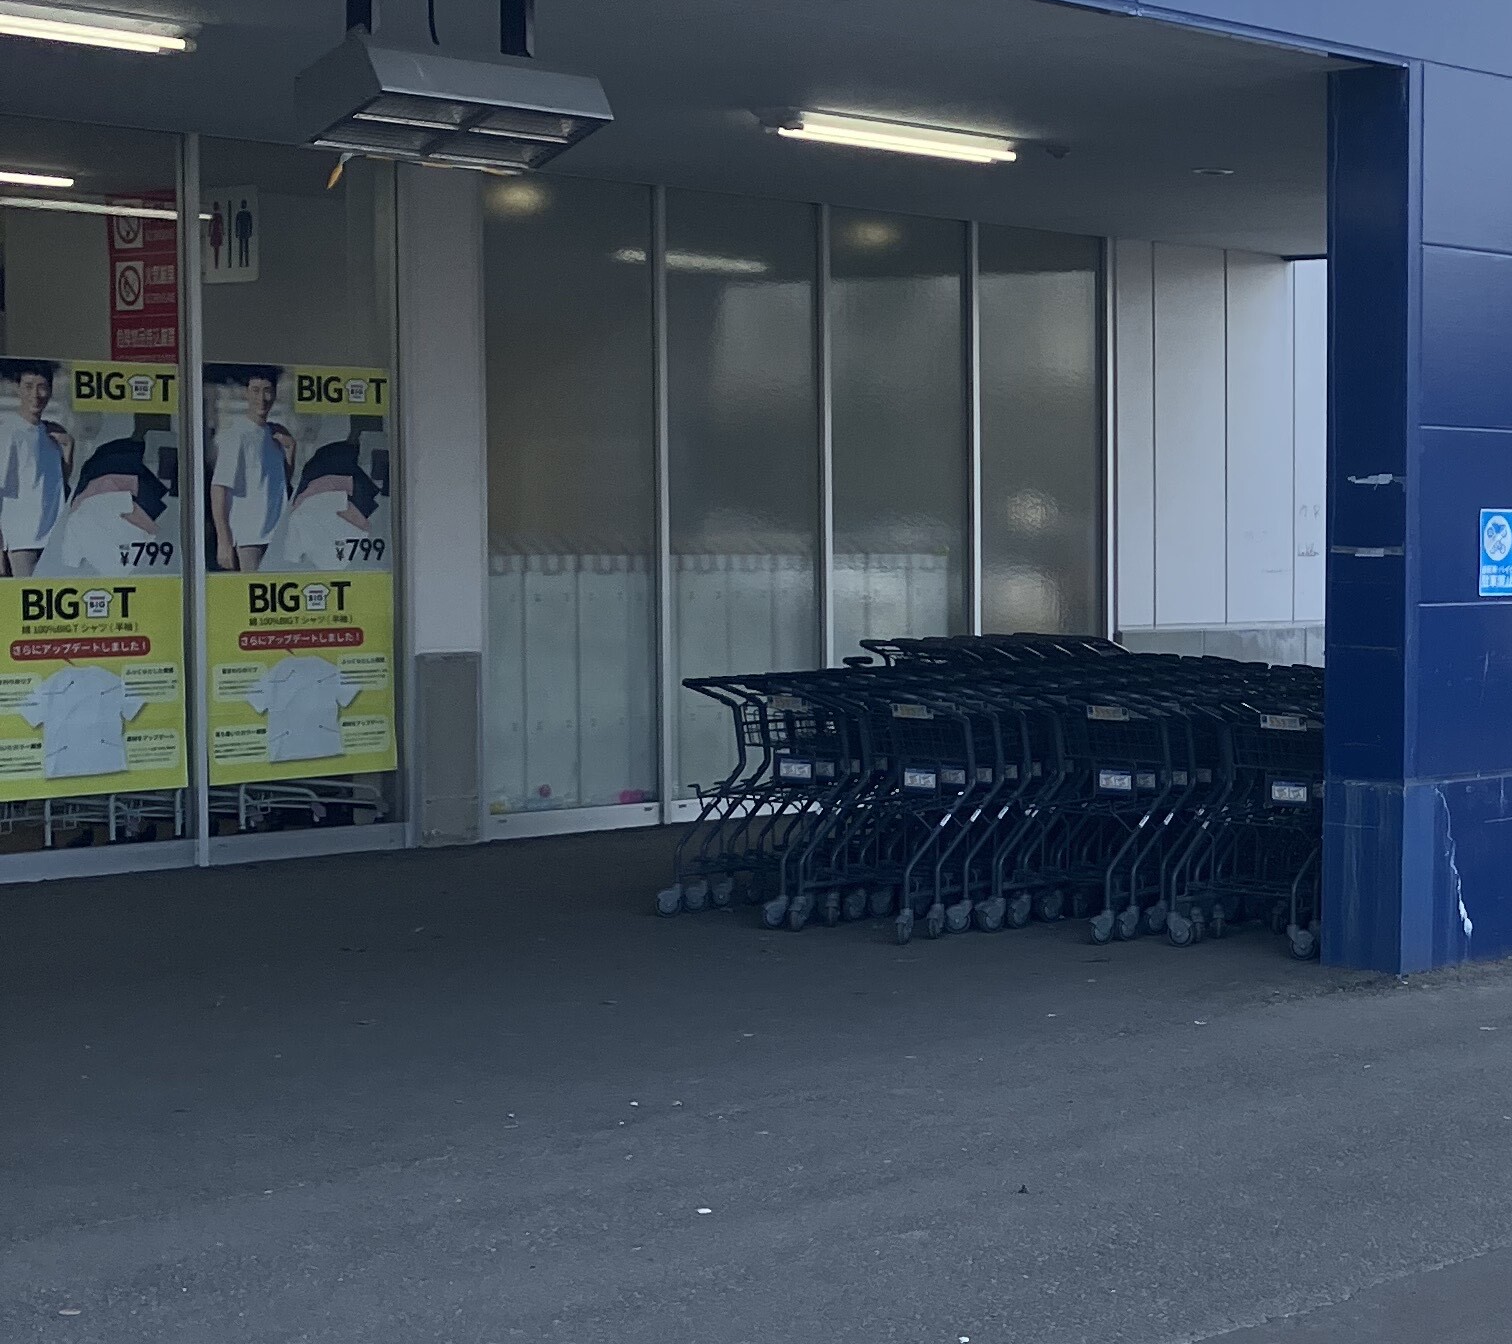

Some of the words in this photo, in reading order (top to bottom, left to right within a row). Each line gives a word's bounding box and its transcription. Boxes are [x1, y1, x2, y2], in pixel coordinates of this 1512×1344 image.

[74, 370, 126, 401] BIG
[156, 374, 175, 402] T
[297, 374, 343, 404] BIG
[369, 378, 387, 404] T
[120, 542, 174, 566] ¥799
[335, 538, 386, 561] ¥799
[22, 587, 80, 621] BIG
[113, 586, 137, 618] T
[248, 581, 300, 613] BIG
[330, 581, 352, 611] T
